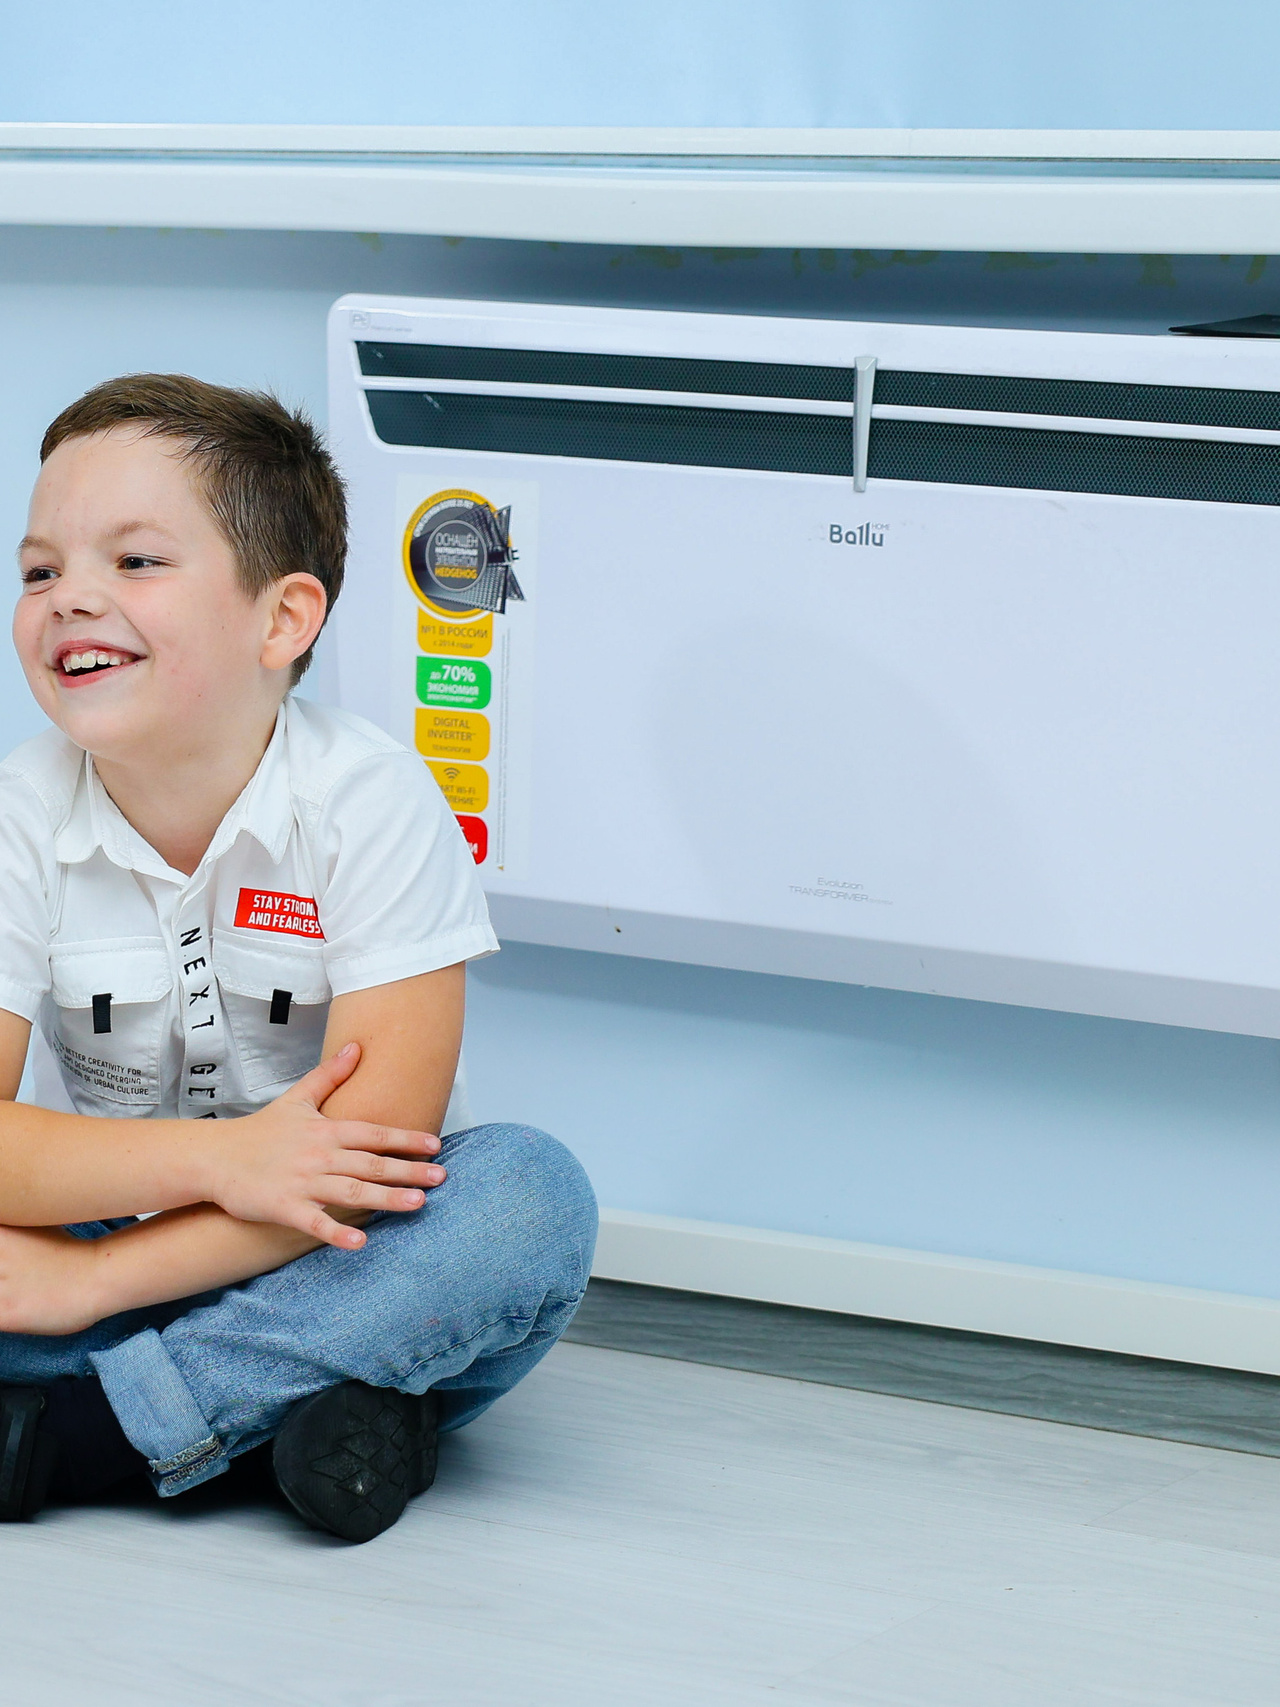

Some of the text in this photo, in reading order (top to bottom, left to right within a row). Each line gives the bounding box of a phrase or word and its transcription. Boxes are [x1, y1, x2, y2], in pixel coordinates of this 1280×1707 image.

[829, 521, 884, 547] Ballu
[434, 567, 478, 579] HEDGEHOG
[447, 627, 488, 638] РОССИИ
[441, 664, 476, 683] 70%
[427, 682, 479, 696] ЭКОНОМИЯ
[433, 716, 470, 729] DIGITAL
[817, 876, 864, 890] Evolution
[788, 885, 869, 902] TRANSFORMER
[253, 894, 317, 917] STAY STRON
[248, 911, 321, 934] AND FEARLESS
[180, 926, 215, 1032] NEXT
[74, 1060, 105, 1077] DESIGNED
[106, 1072, 142, 1085] EMERGING
[88, 1056, 125, 1073] CREATIVITY
[127, 1067, 142, 1076] FOR
[94, 1077, 116, 1091] URBAN
[116, 1085, 149, 1096] CULTURE
